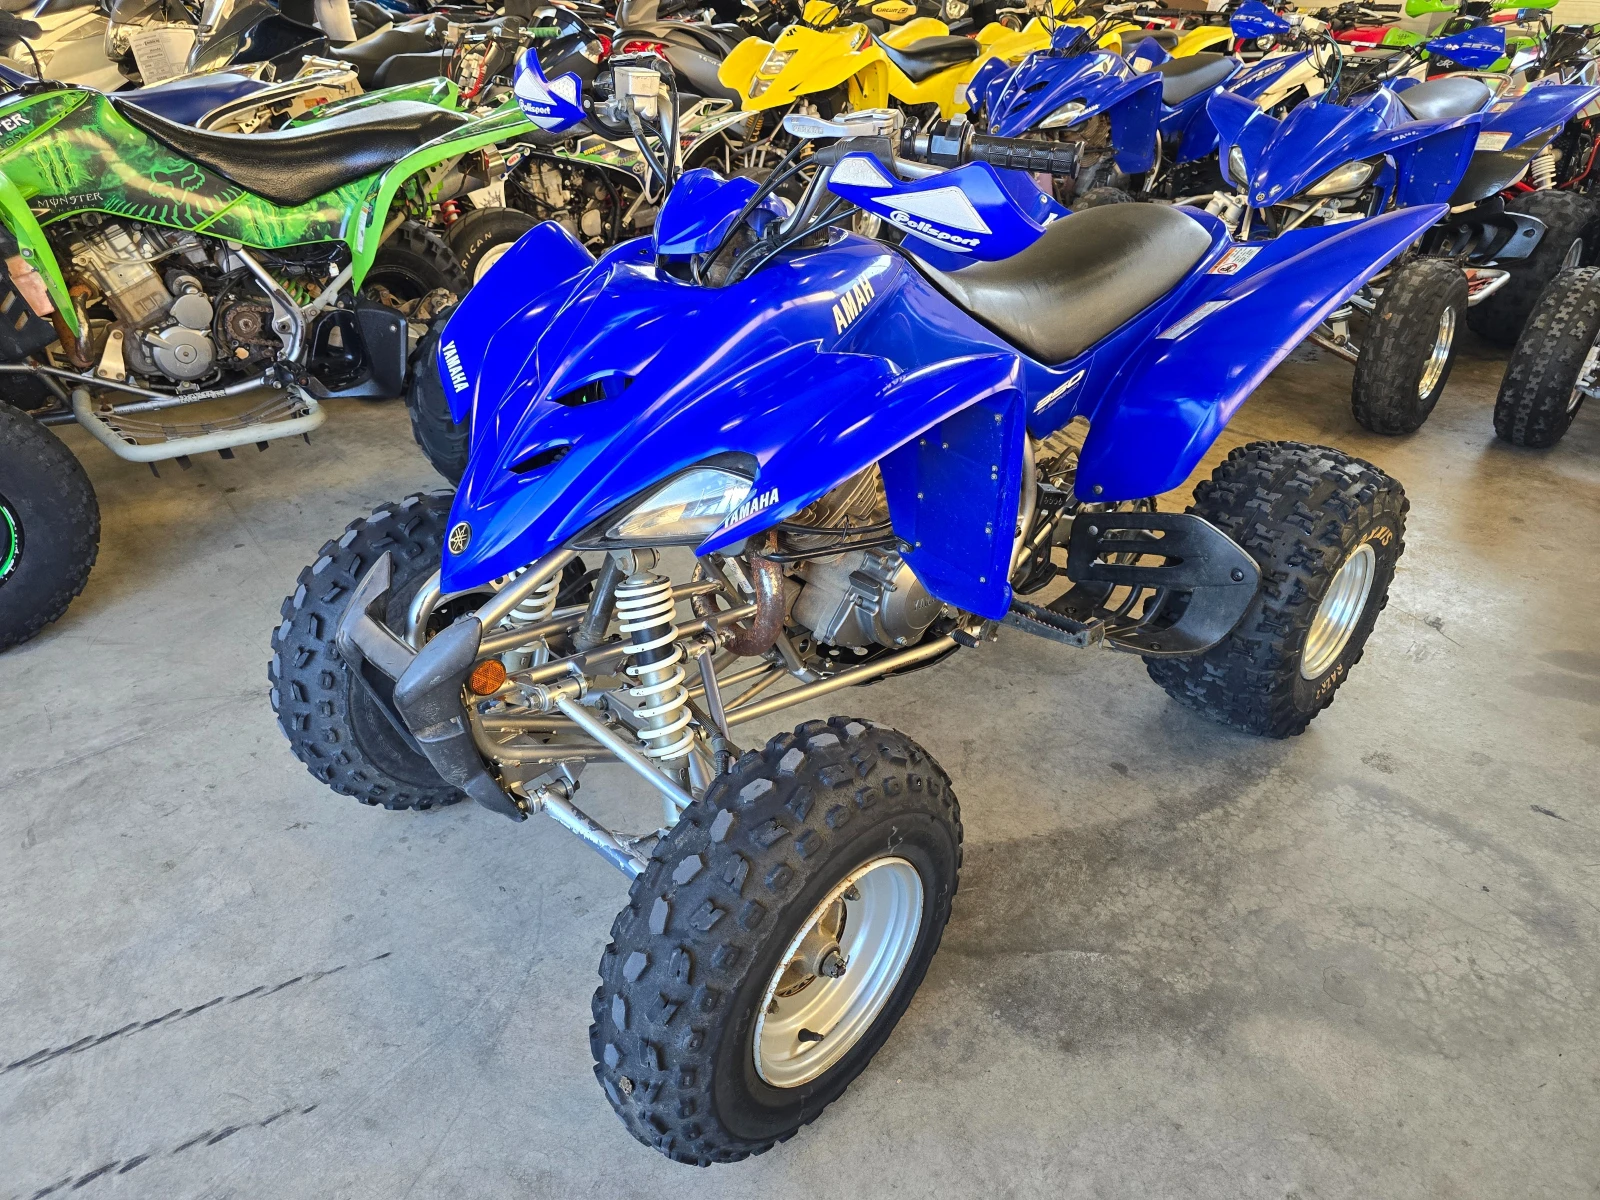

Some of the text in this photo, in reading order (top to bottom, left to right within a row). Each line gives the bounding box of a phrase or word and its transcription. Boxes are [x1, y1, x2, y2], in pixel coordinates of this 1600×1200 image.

[1232, 14, 1263, 22] ZETA
[1460, 42, 1502, 51] ZETA
[37, 192, 104, 208] MONSTER
[889, 210, 981, 248] Polisport
[461, 231, 493, 271] RICAN
[831, 272, 876, 336] AMAH
[442, 340, 470, 394] YAMAHA
[724, 487, 780, 529] YAMAHA
